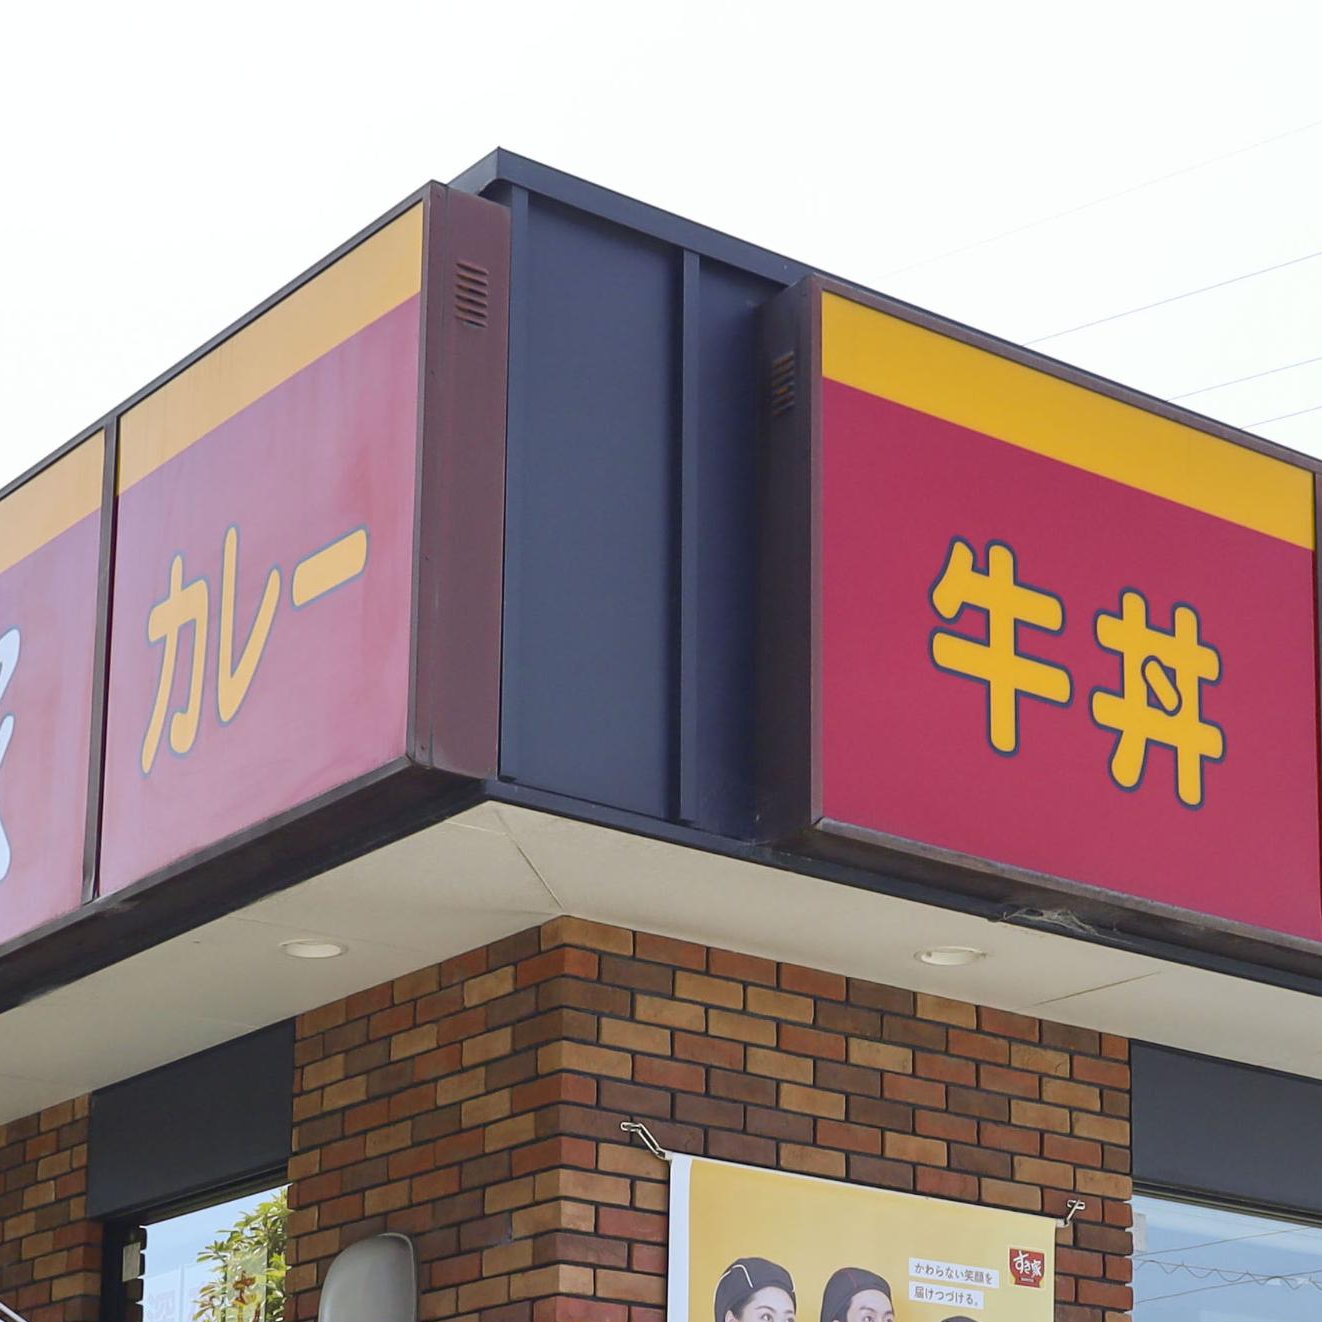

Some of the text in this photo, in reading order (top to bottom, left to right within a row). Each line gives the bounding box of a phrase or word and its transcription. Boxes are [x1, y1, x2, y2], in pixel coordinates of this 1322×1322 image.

[140, 525, 370, 775] カレー
[929, 537, 1225, 806] 牛丼
[914, 1263, 993, 1285] かわらない笑顔を
[1013, 1250, 1042, 1278] すき家
[914, 1286, 978, 1306] 届けつづける。
